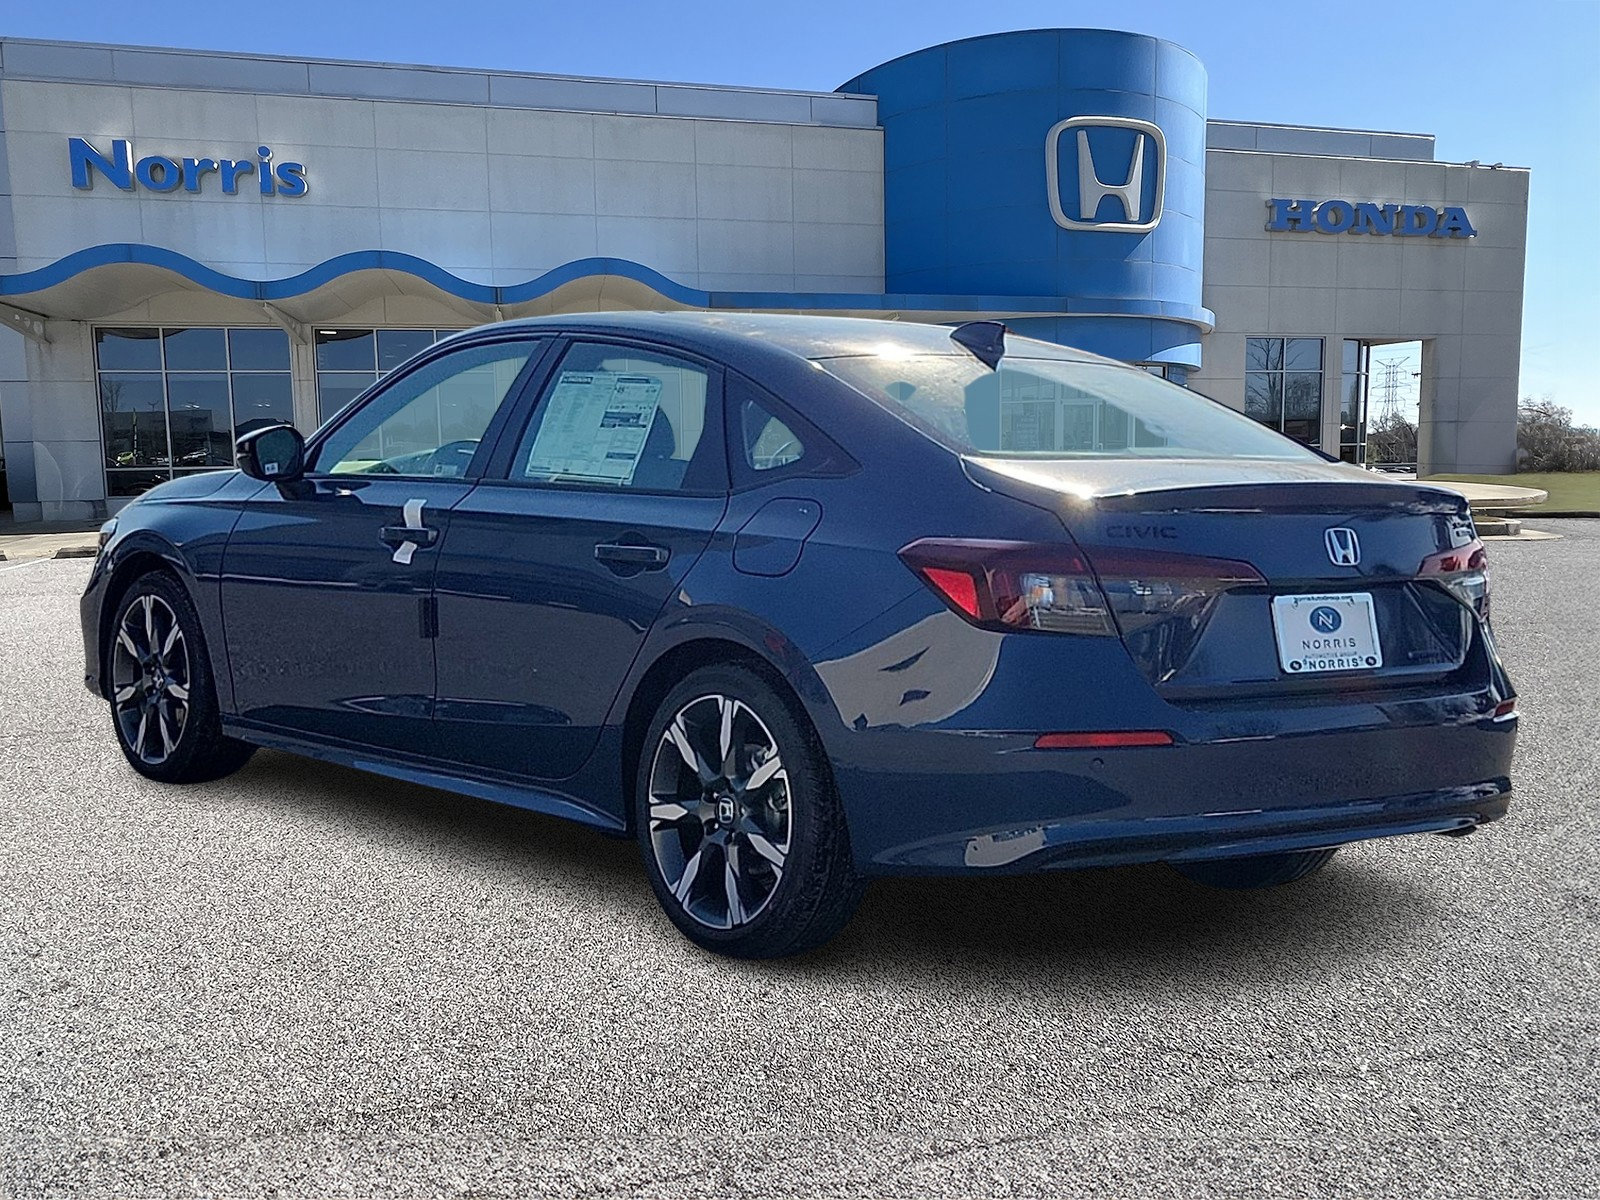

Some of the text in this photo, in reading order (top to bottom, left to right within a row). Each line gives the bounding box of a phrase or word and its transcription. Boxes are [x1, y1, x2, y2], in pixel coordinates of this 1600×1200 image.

[68, 137, 309, 197] Norris
[1265, 198, 1478, 239] HONDA
[1106, 525, 1178, 539] CIVIC
[1302, 638, 1356, 650] NORRIS
[1308, 658, 1359, 669] NORRIS
